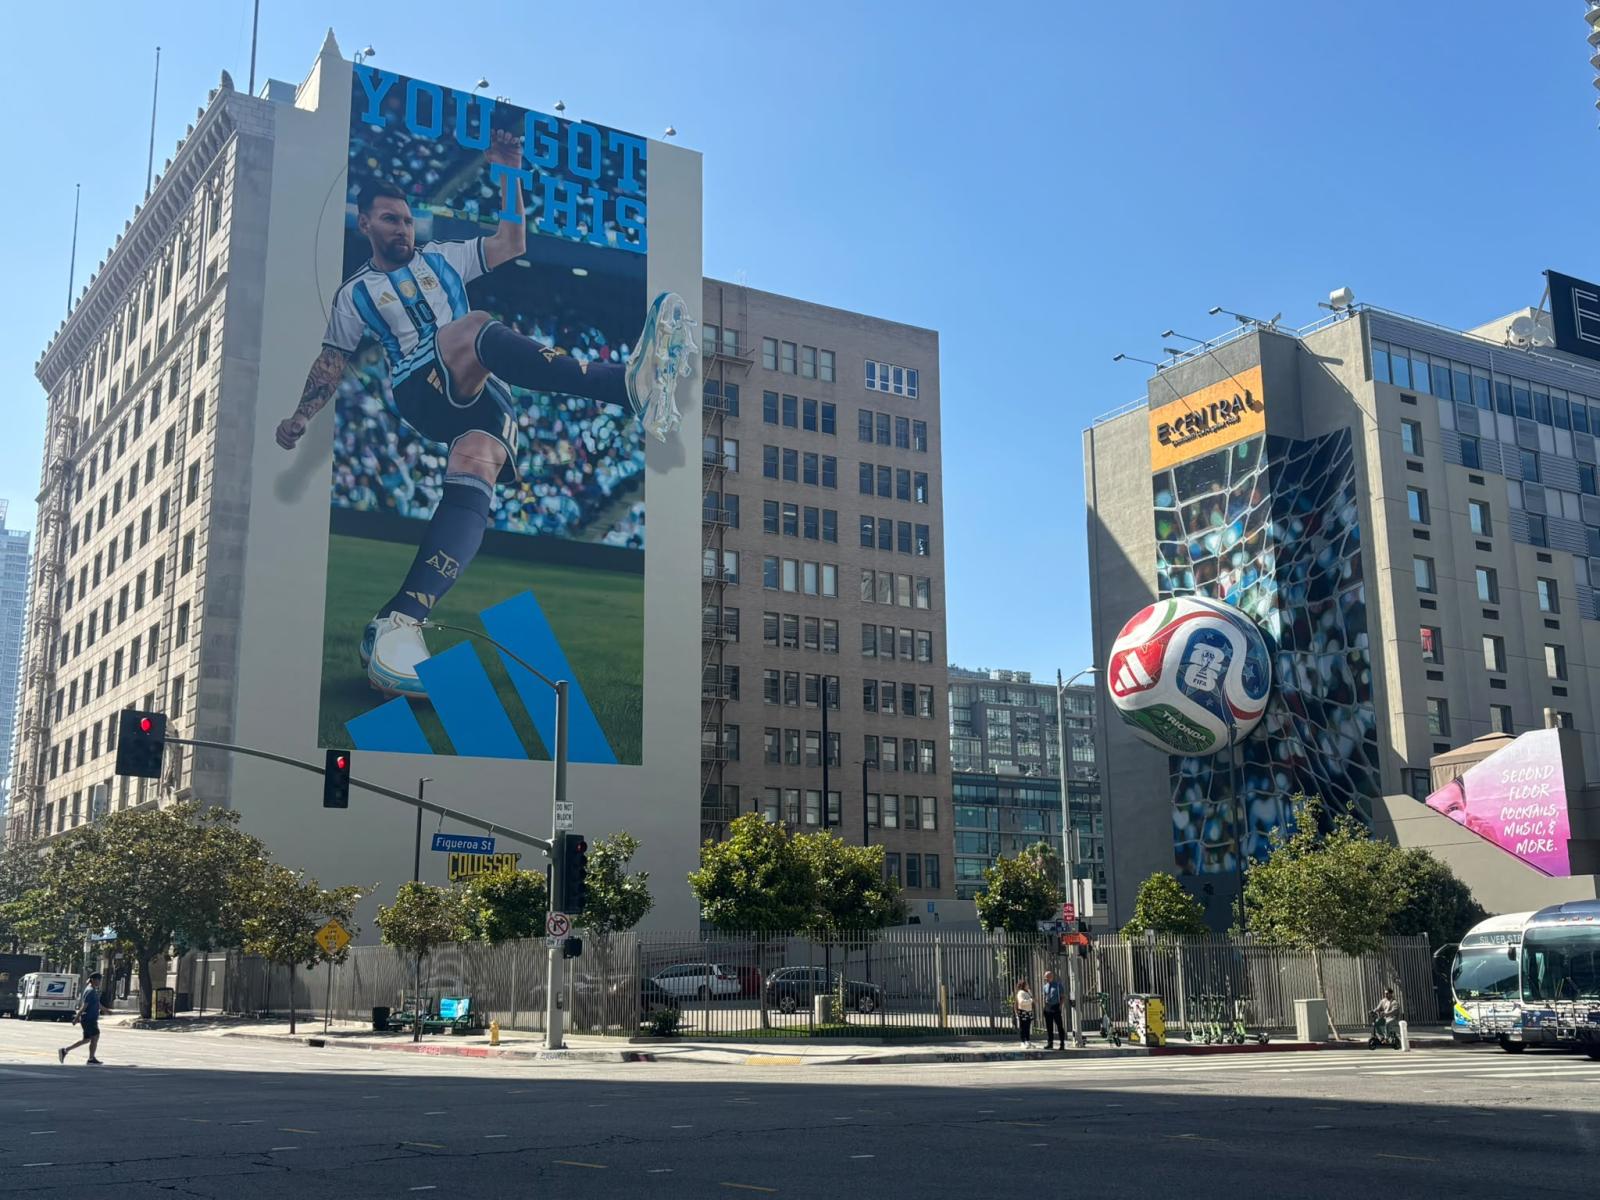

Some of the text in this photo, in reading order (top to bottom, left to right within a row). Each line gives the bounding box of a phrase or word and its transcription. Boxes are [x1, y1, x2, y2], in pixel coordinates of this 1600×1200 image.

[352, 63, 647, 191] YOU GOT
[490, 163, 647, 254] THIS
[1193, 678, 1207, 687] FIFA
[1163, 710, 1207, 741] TRIONDA
[1501, 765, 1554, 784] SECOND
[1509, 783, 1549, 801] FLOOR
[556, 813, 571, 821] BLOCK
[1500, 803, 1559, 821] COCKTAILS,
[1503, 820, 1546, 837] MUSIC,
[436, 837, 492, 850] Figueroa St
[1516, 838, 1558, 855] MORE.
[1480, 935, 1505, 944] SILVER
